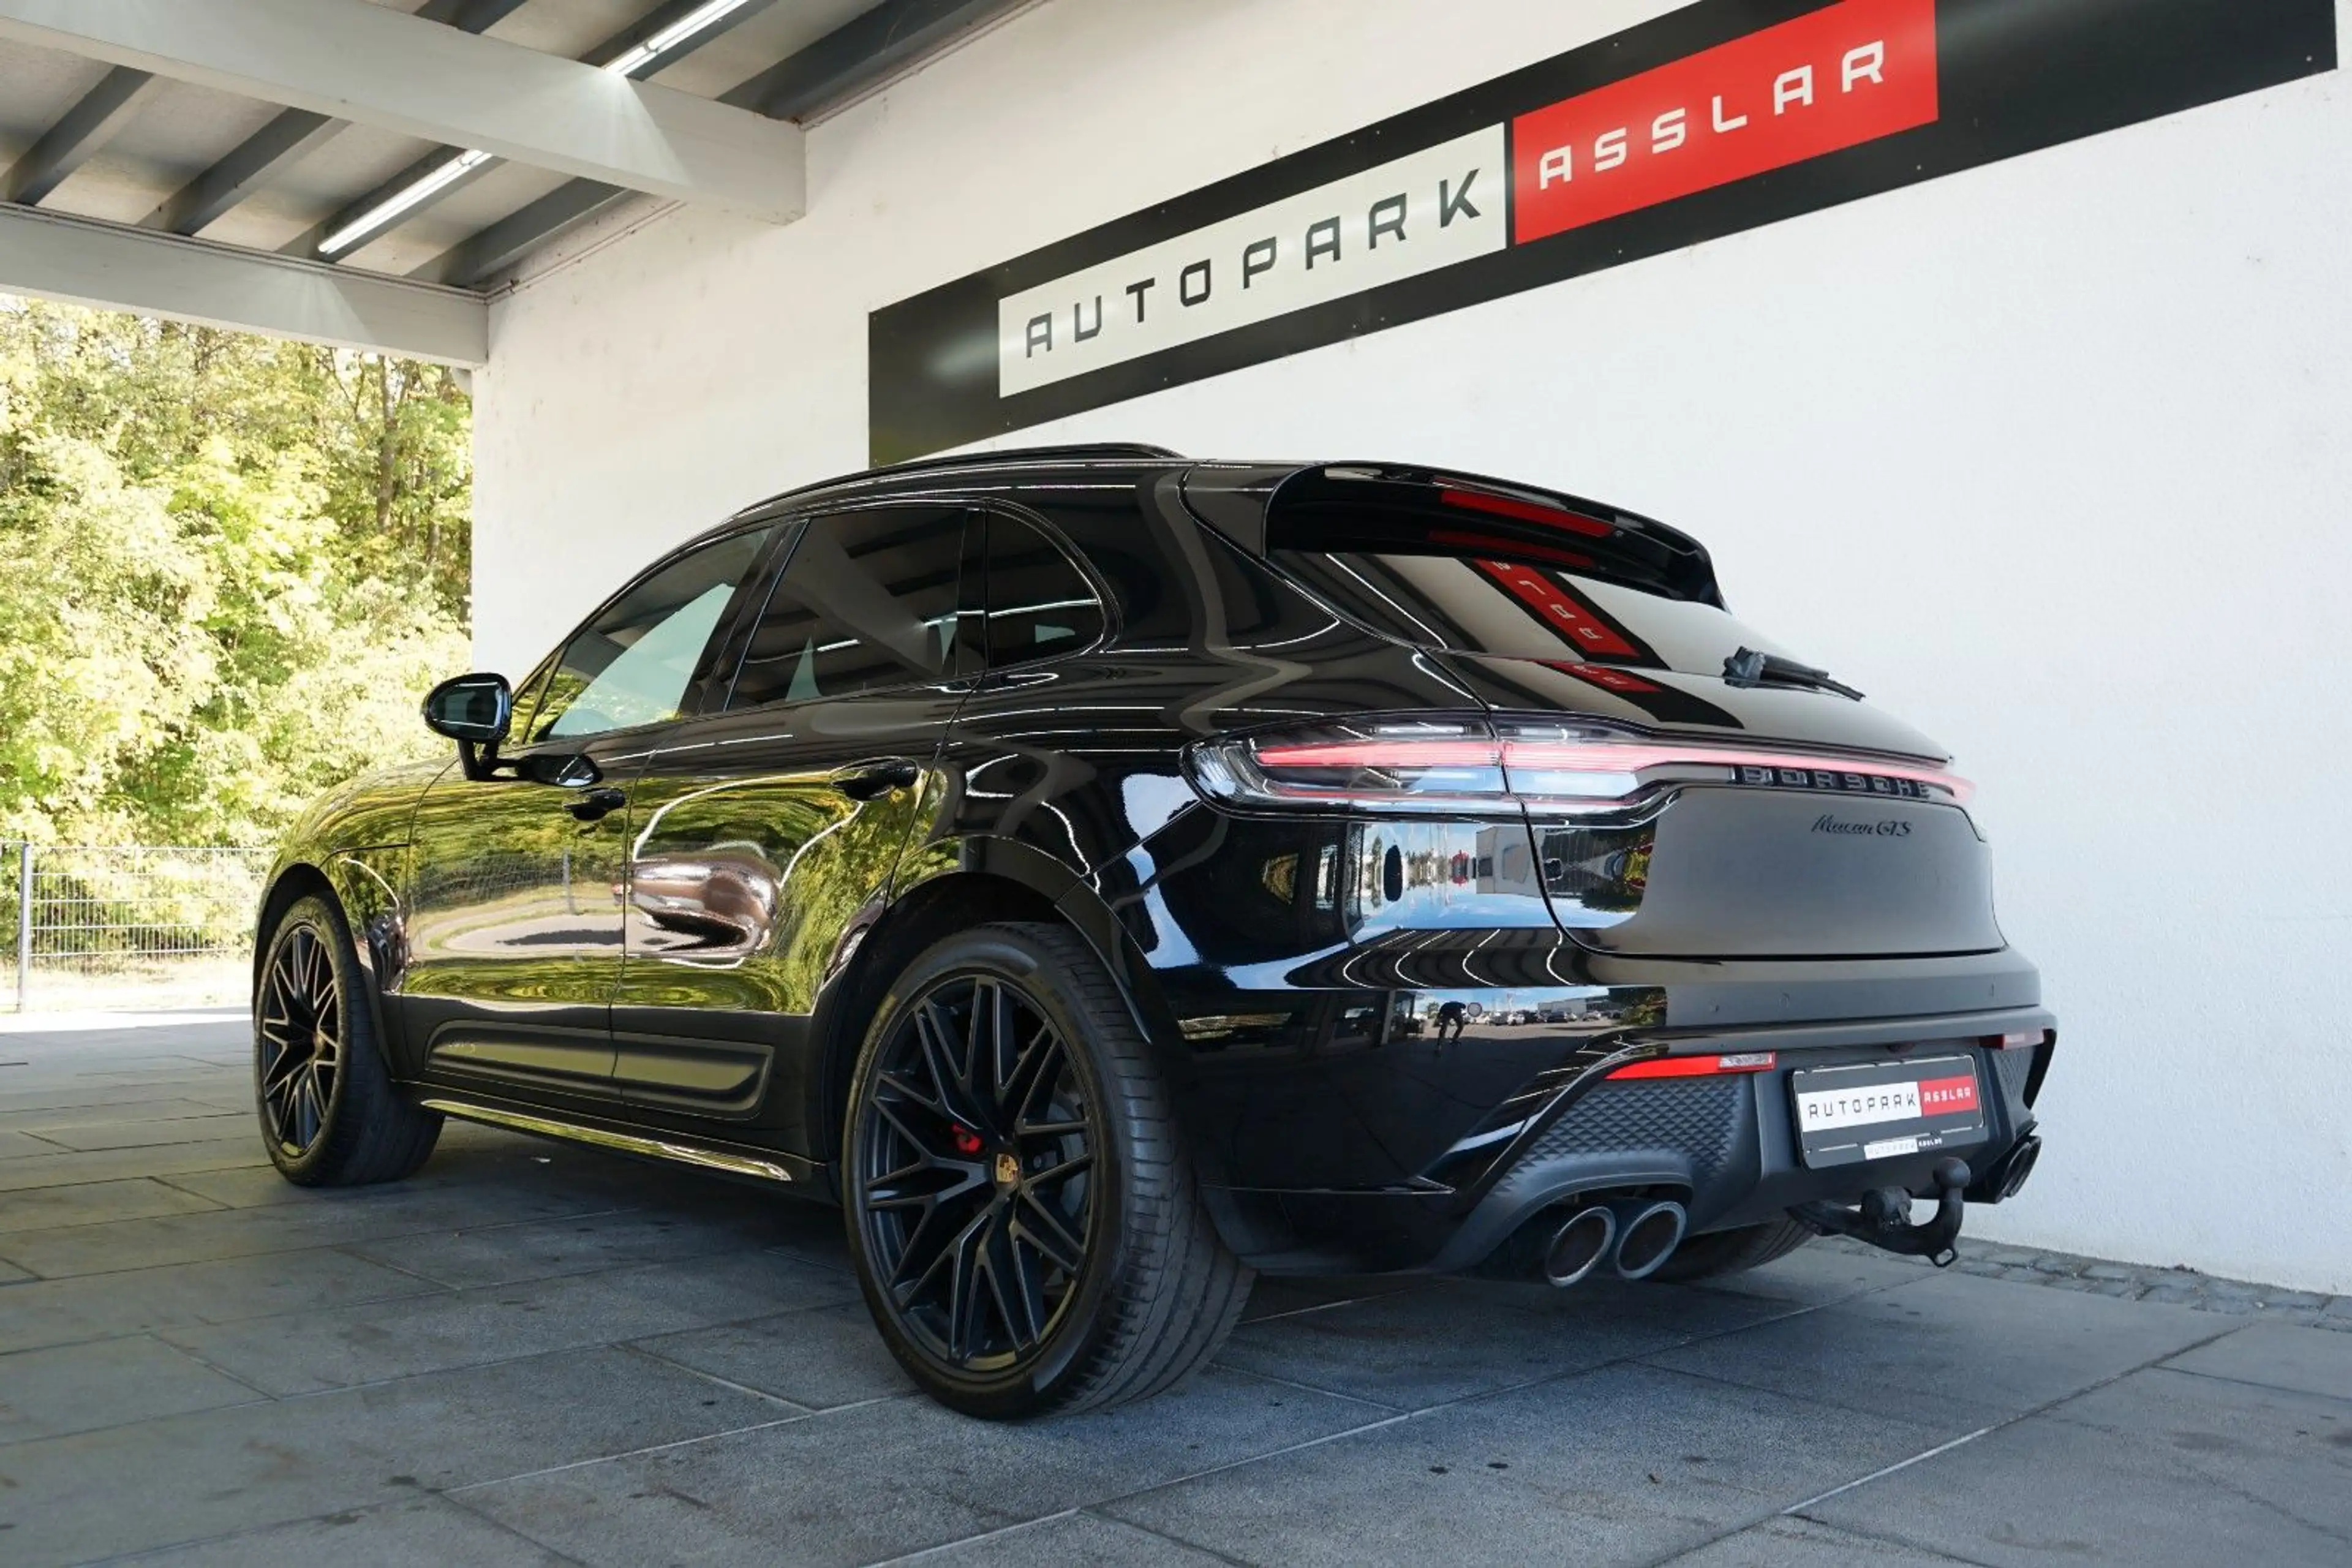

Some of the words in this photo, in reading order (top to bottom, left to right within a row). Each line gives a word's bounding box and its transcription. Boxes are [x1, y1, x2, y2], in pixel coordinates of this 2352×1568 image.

[1025, 169, 1481, 358] AUTOPARK
[1539, 41, 1884, 189] ASSLAR
[1741, 767, 1931, 797] PORSCHE
[1811, 814, 1873, 835] Macan
[1877, 820, 1912, 837] GTS
[1808, 1093, 1917, 1119] AUTOPARK
